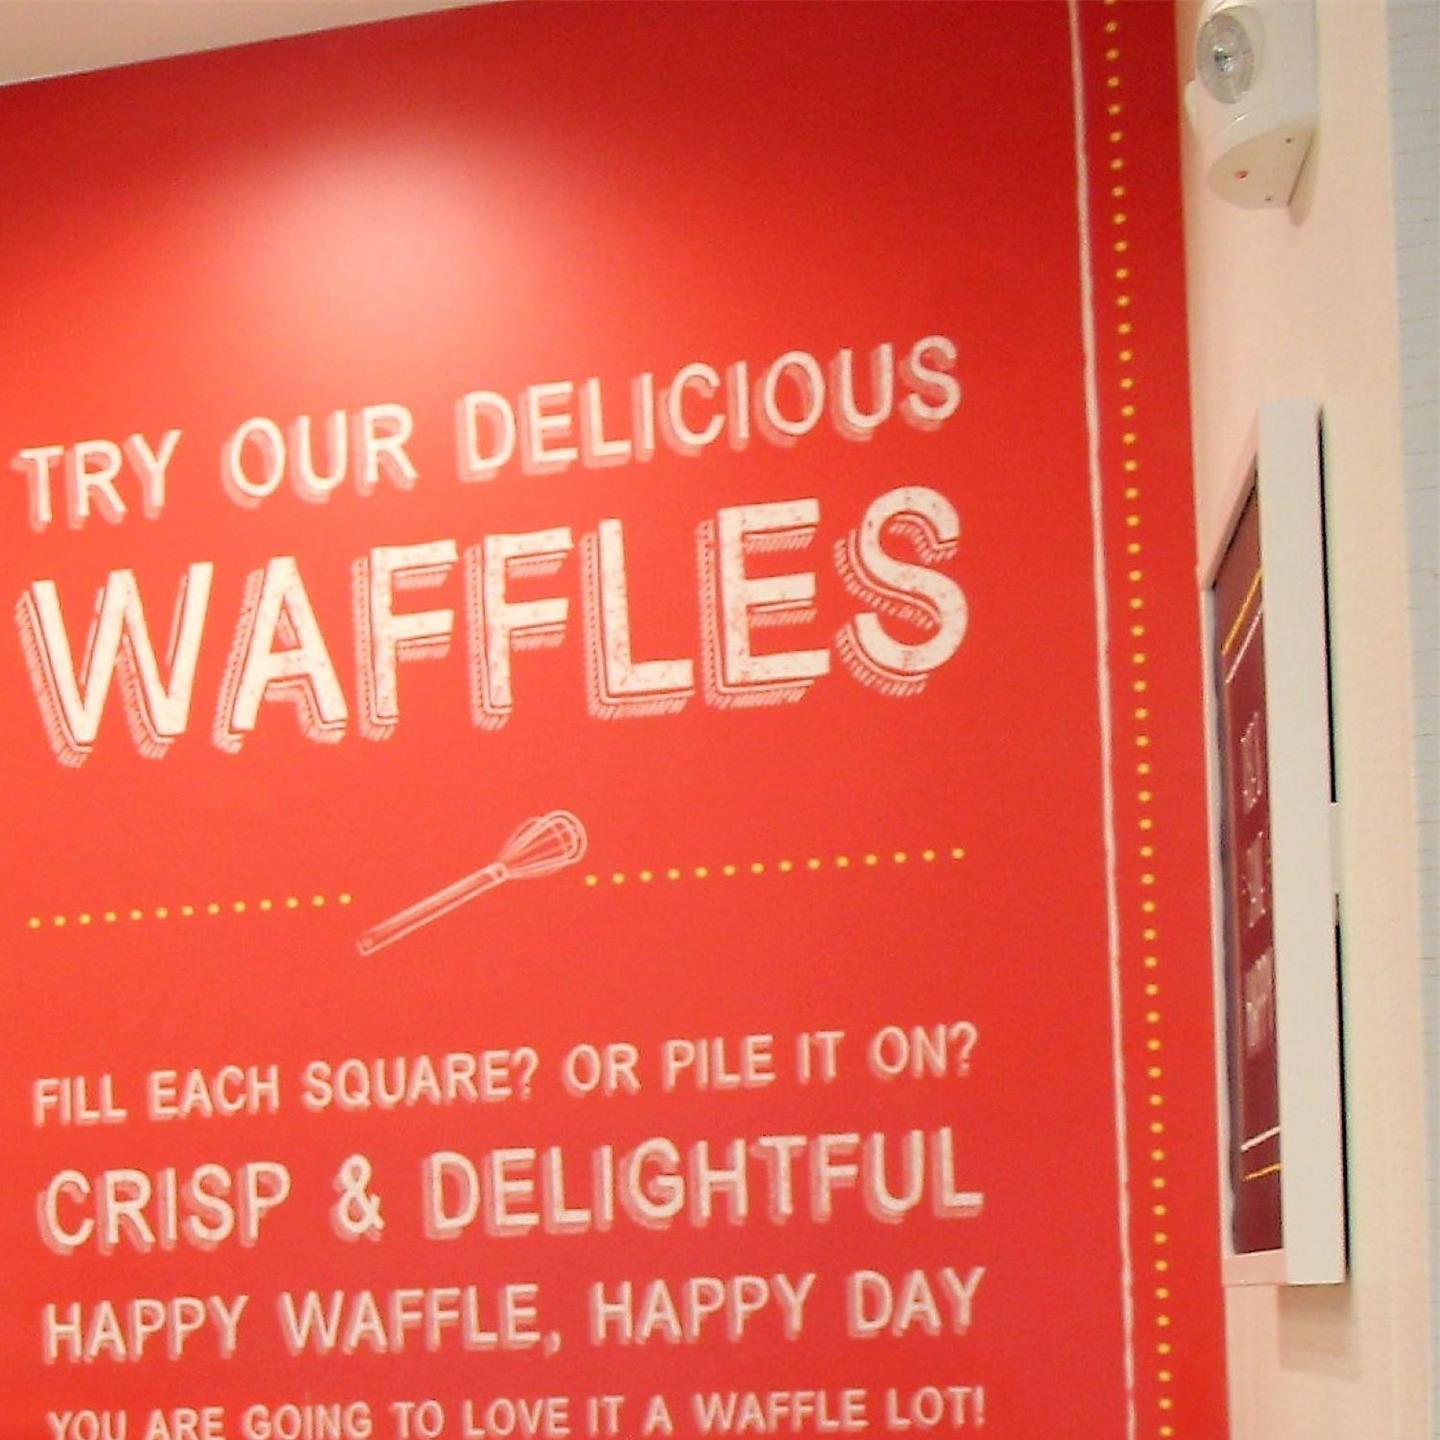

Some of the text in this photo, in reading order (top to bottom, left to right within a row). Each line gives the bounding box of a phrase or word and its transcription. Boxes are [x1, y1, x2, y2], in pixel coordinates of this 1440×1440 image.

[11, 334, 965, 533] TRY OUR DELICIOUS
[12, 484, 971, 771] WAFFLES
[32, 1020, 978, 1128] FILL EACH SQUARE? OR PILE IT ON?
[35, 1126, 984, 1256] CRISP & DELIGHTFUL
[41, 1265, 987, 1365] HAPPY WAFFLE, HAPPY DAY
[462, 1397, 570, 1440] LOVE
[587, 1395, 625, 1439] IT
[641, 1394, 674, 1438] A
[694, 1388, 869, 1437] WAFFLE
[886, 1385, 986, 1430] LOT!
